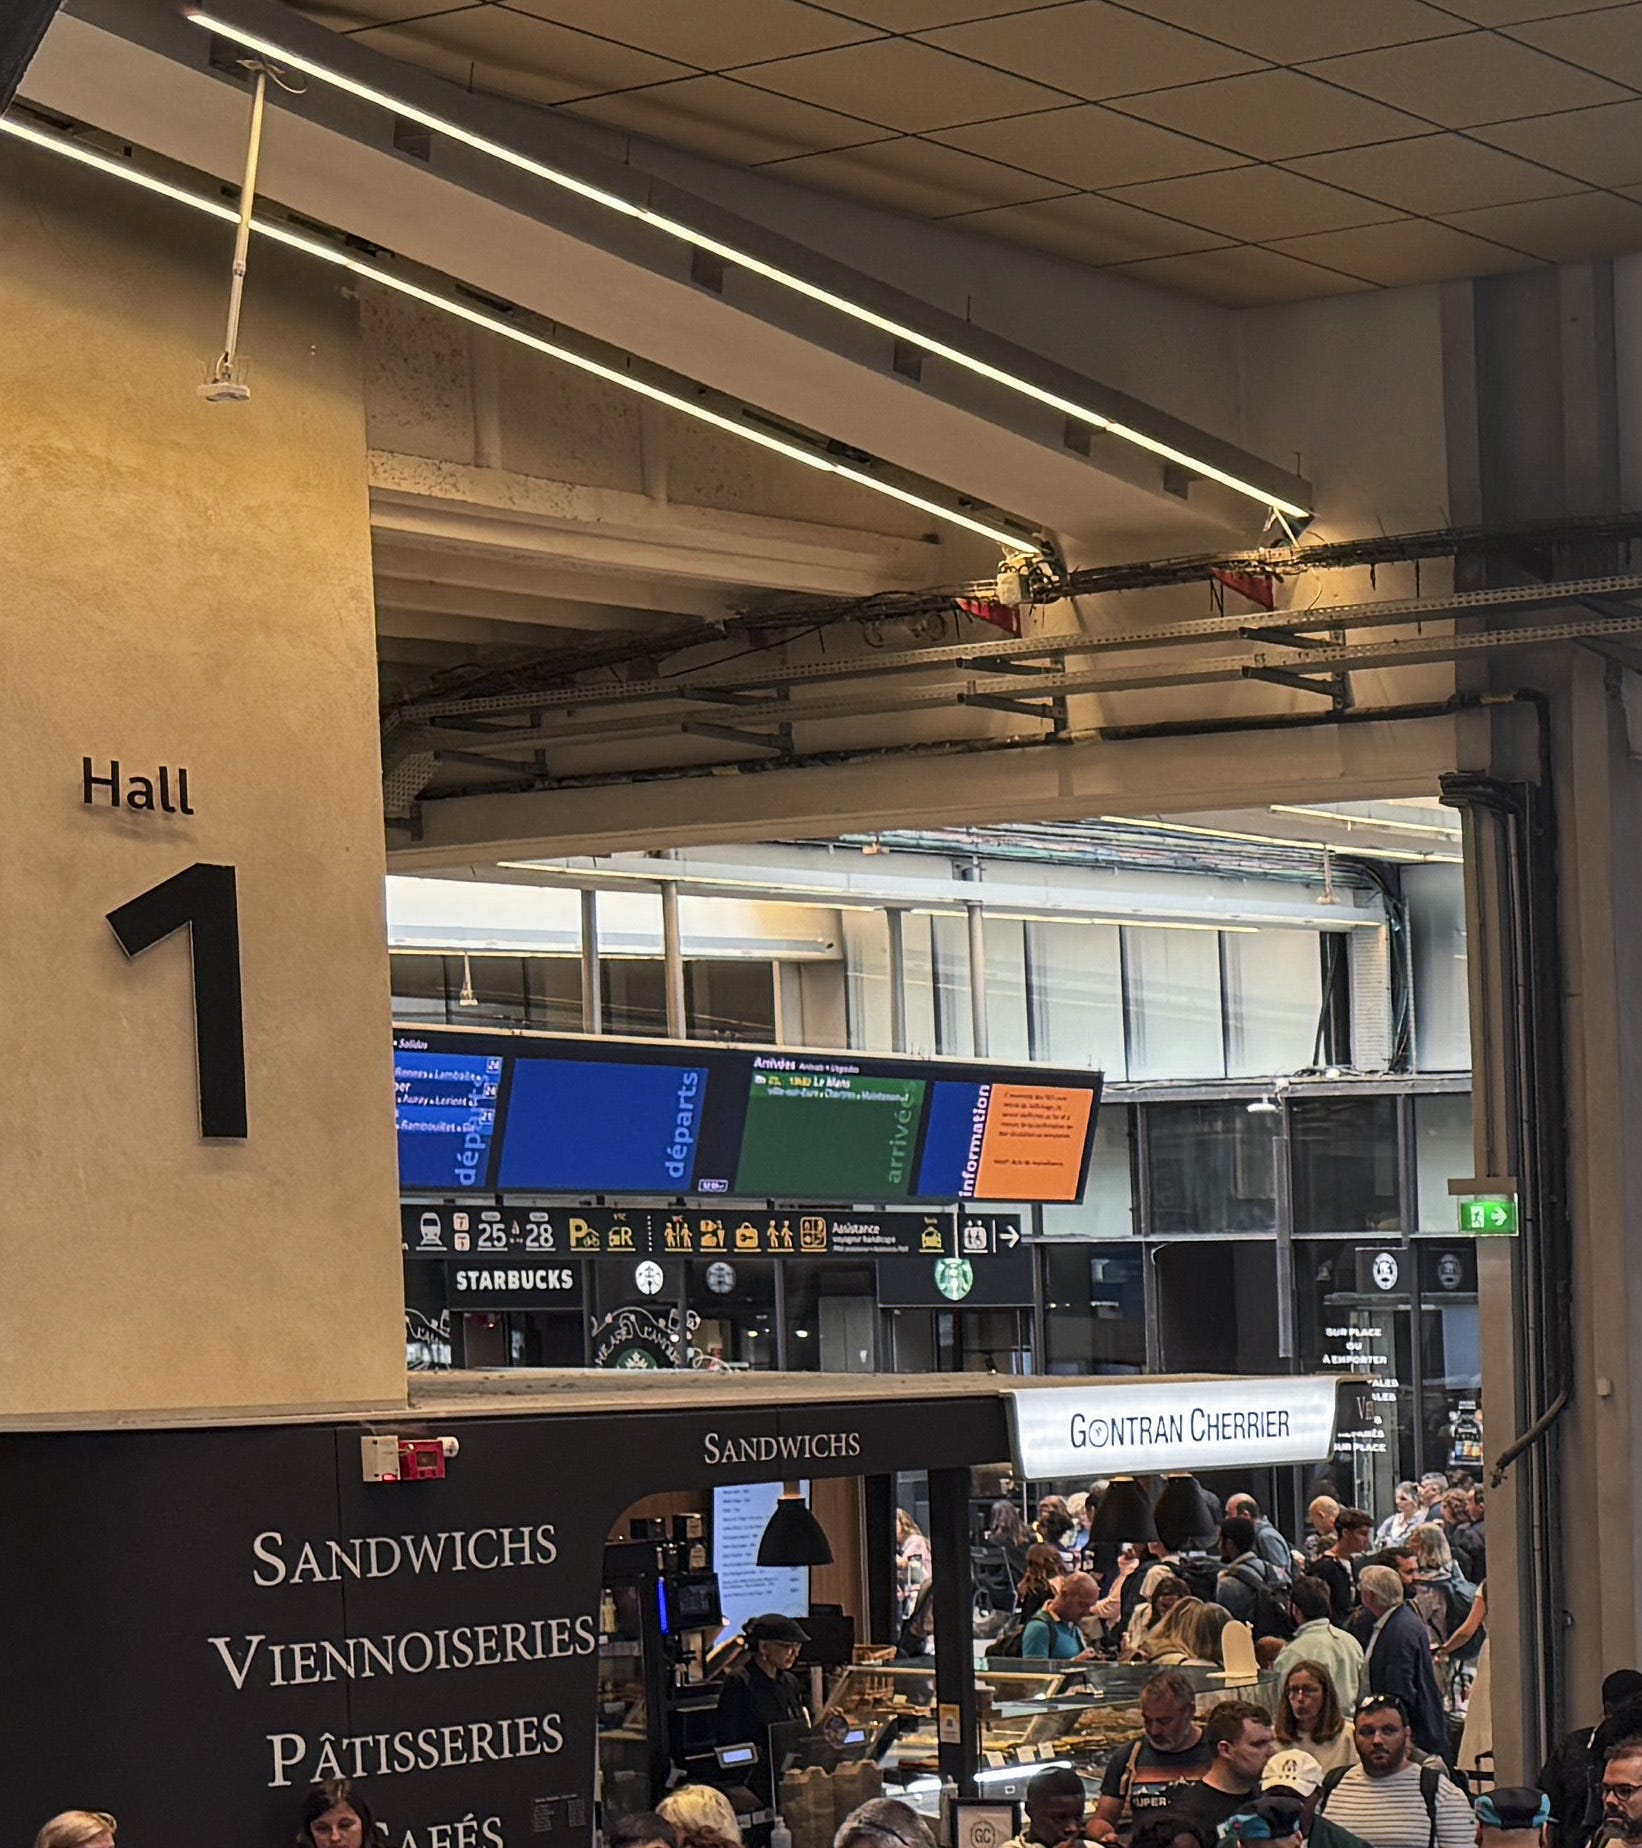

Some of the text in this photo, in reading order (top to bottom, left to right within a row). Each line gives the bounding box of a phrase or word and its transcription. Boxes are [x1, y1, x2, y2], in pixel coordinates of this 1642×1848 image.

[82, 757, 194, 815] Hall
[105, 862, 247, 1139] 1
[665, 1072, 698, 1178] départs
[958, 1084, 990, 1198] information
[478, 1223, 507, 1247] 25
[526, 1223, 554, 1247] 28
[832, 1223, 880, 1235] Assistance
[456, 1268, 574, 1291] STARBUCKS
[703, 1432, 861, 1465] SANDWICHS
[1070, 1408, 1291, 1452] GONTRAN CHERRIER
[252, 1525, 558, 1587] SANDWICHS
[209, 1616, 596, 1690] VIENNOISERIES
[266, 1713, 564, 1788] PÂTISSERIES
